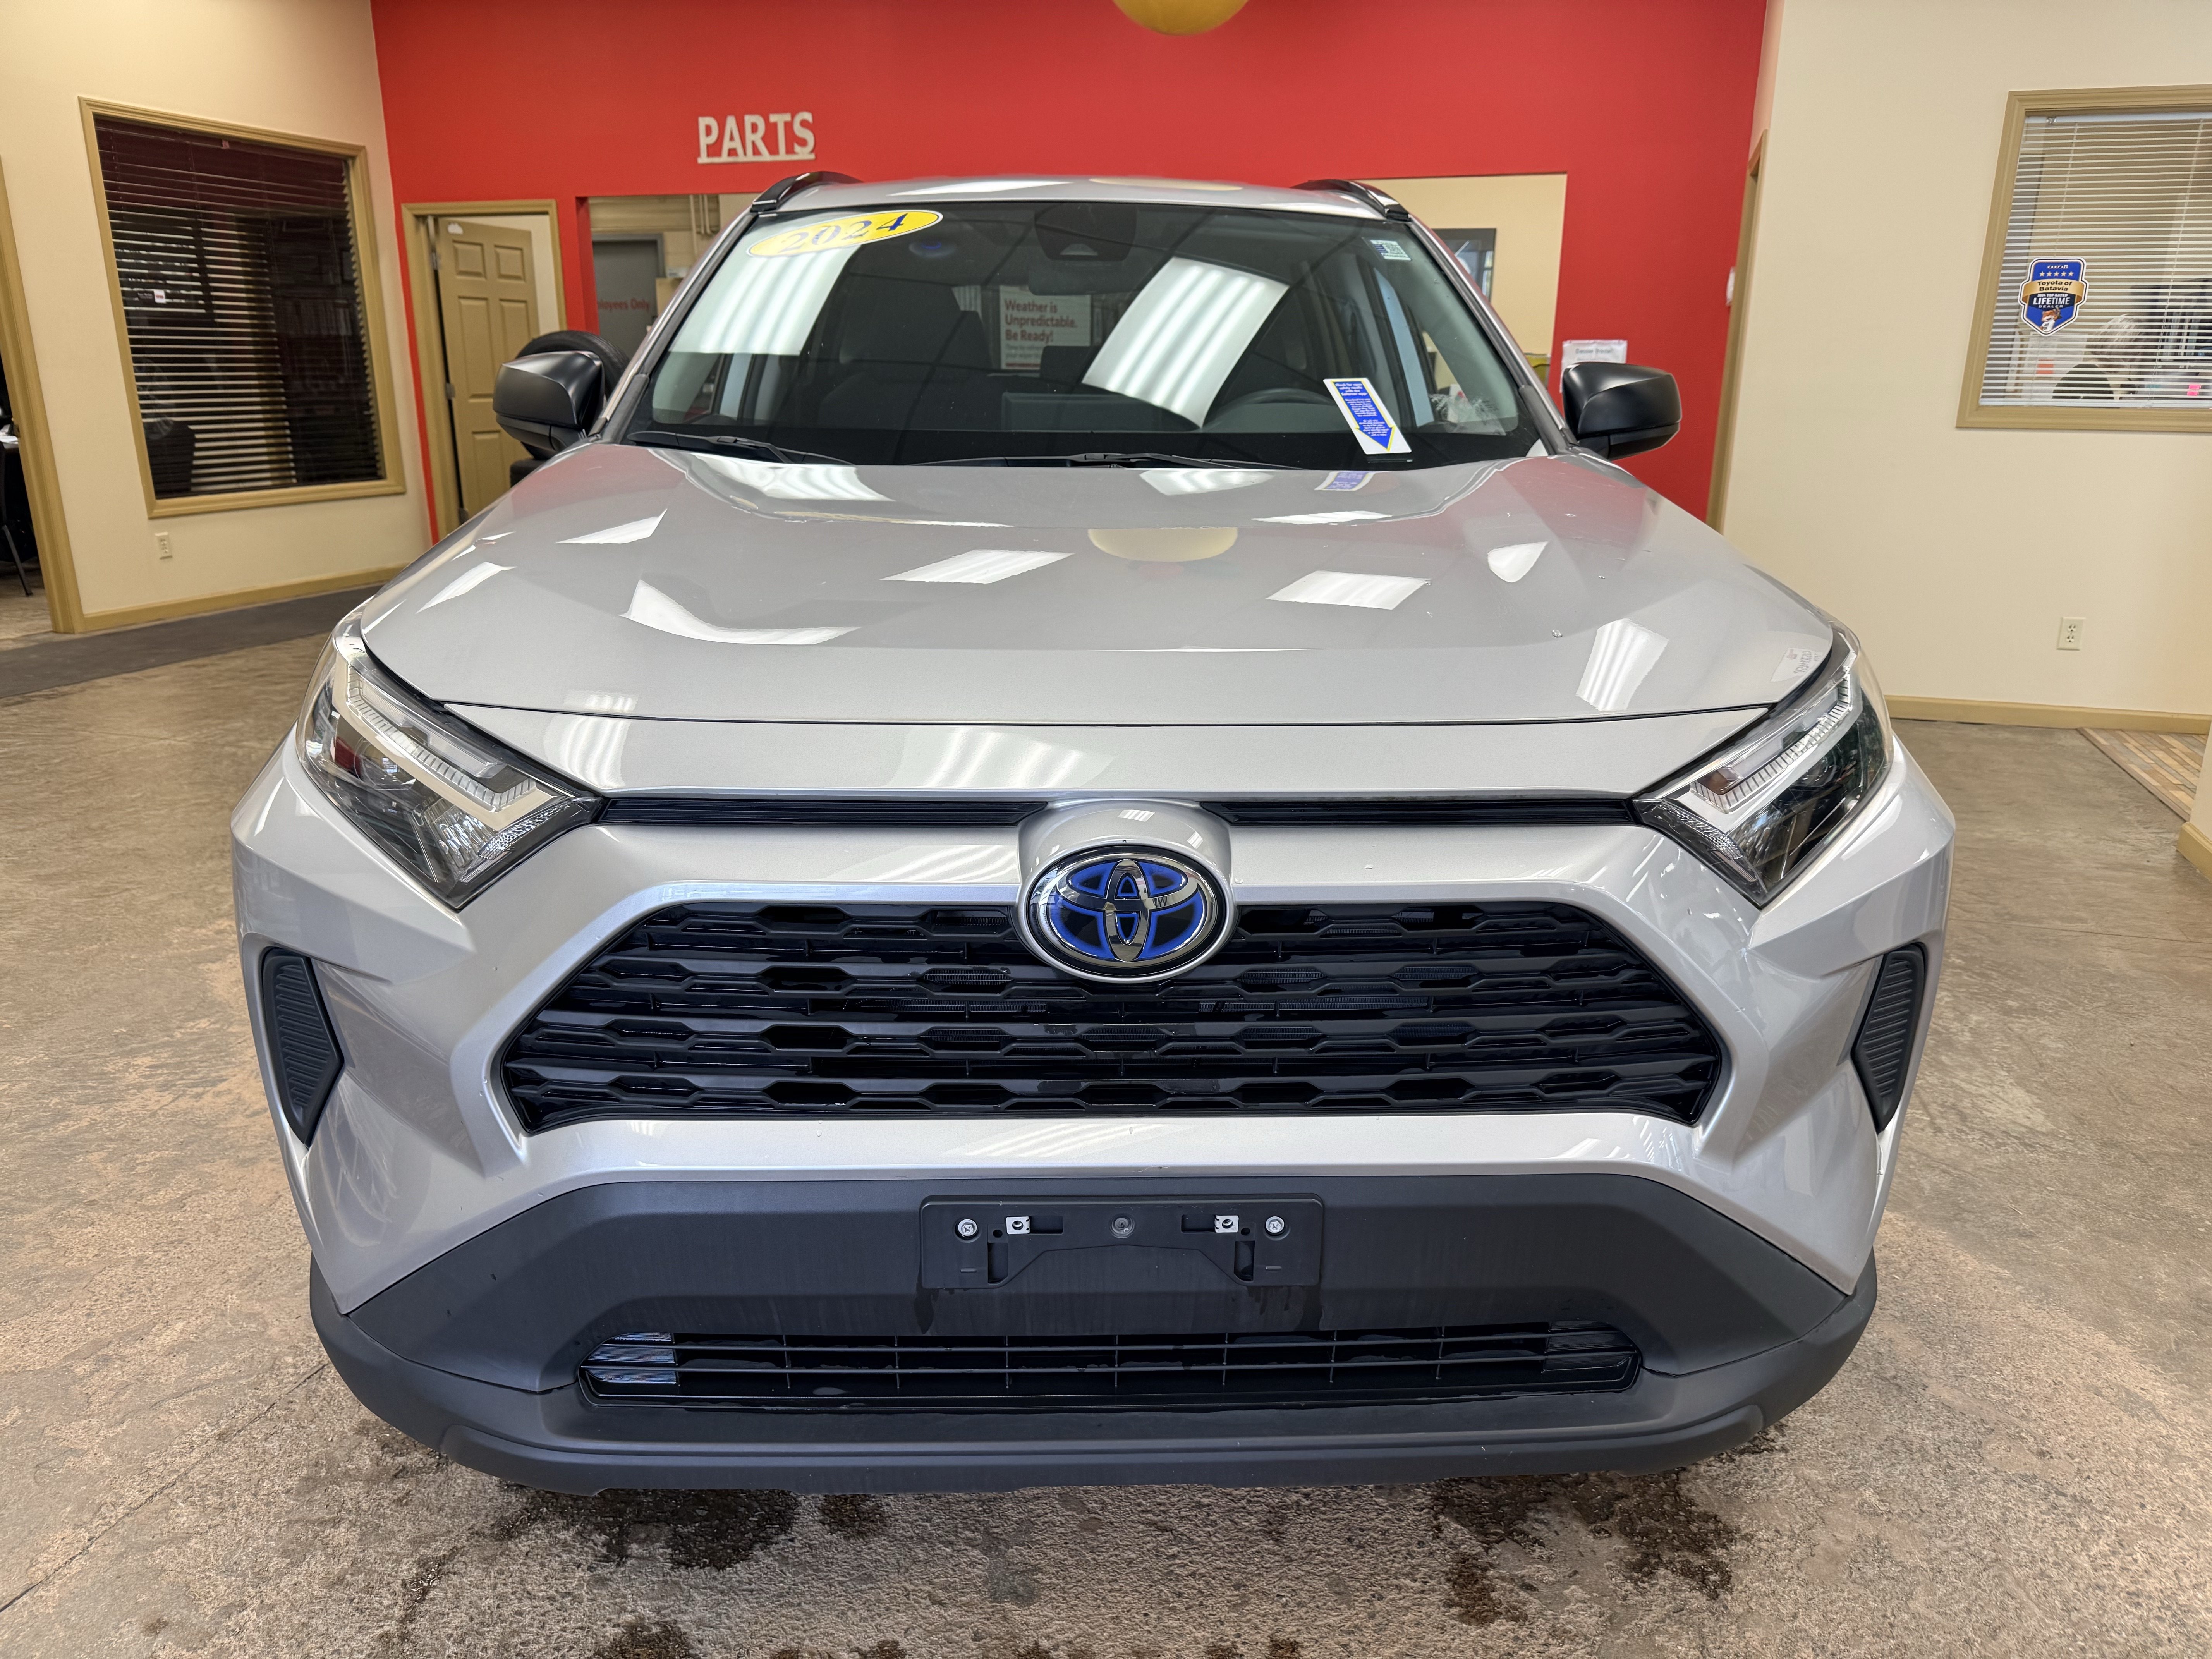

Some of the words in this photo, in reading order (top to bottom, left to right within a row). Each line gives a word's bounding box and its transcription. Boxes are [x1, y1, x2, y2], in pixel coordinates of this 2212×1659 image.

[698, 112, 816, 158] PARTS
[778, 213, 908, 253] 2024
[1005, 299, 1047, 313] Weather
[1049, 301, 1058, 313] is
[1005, 329, 1018, 341] Be
[1020, 330, 1054, 344] Ready!
